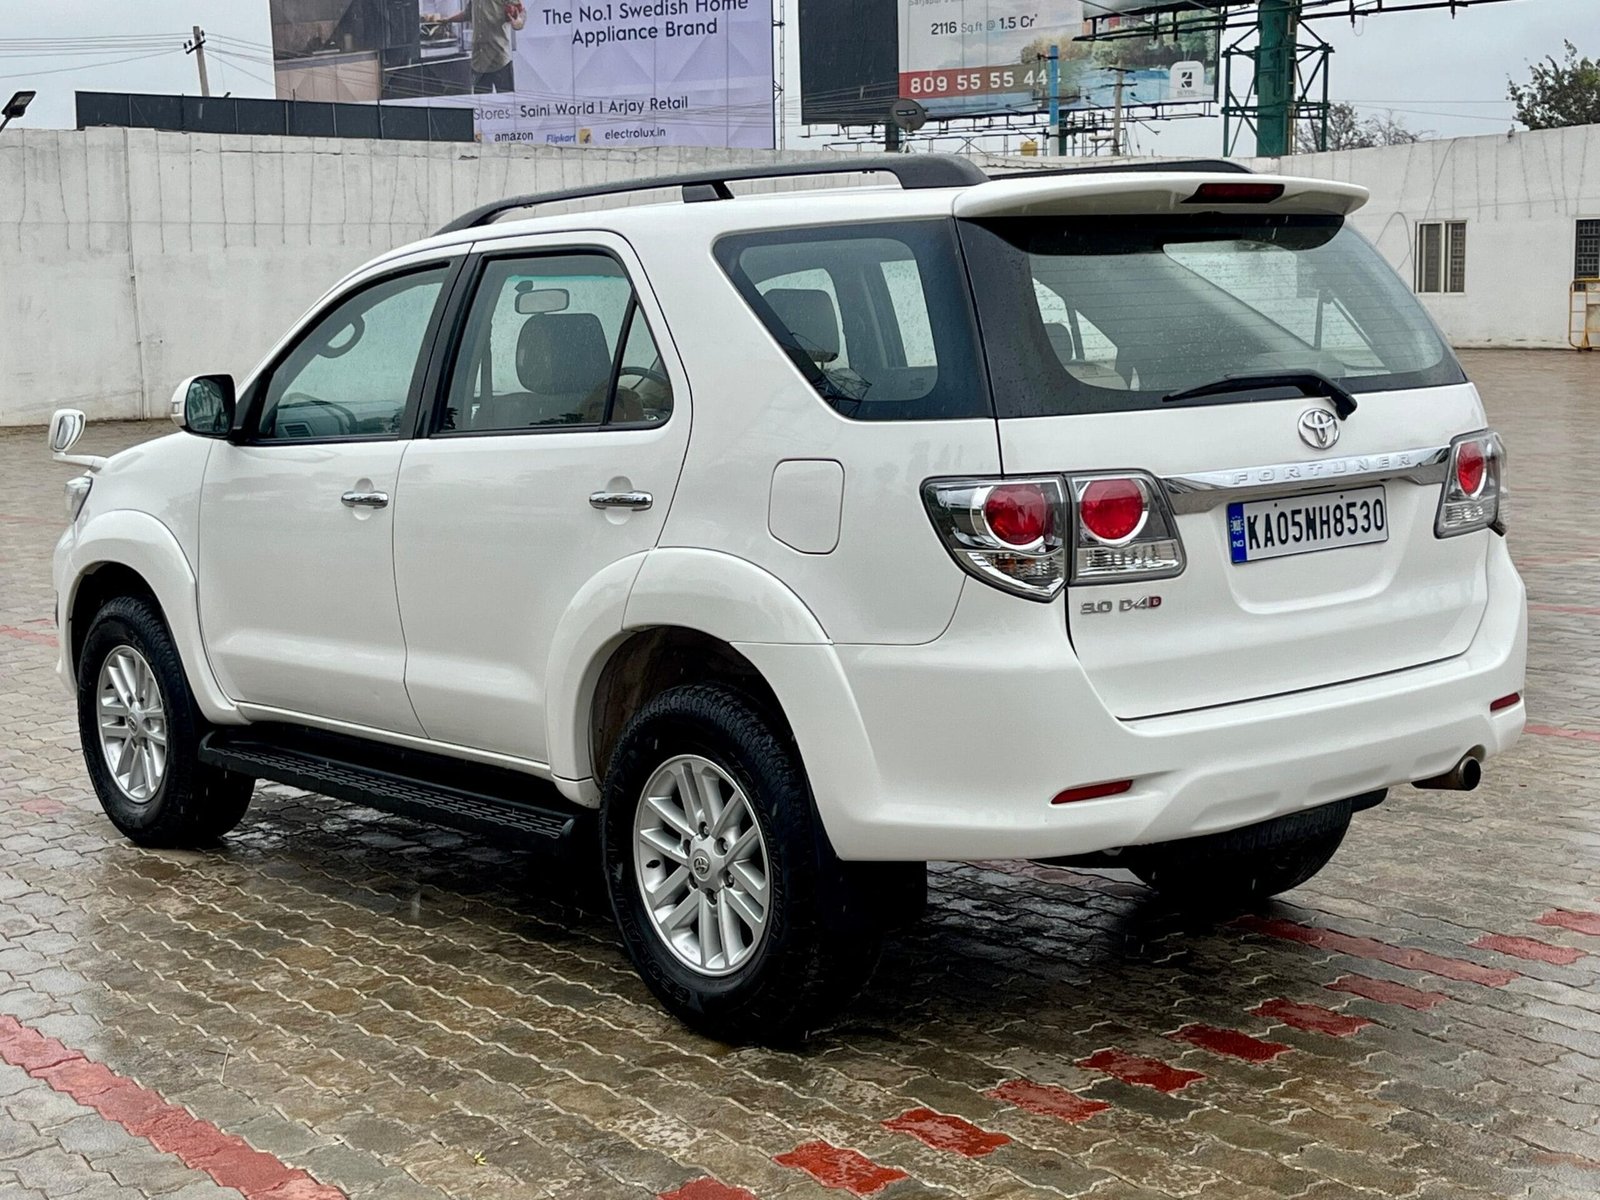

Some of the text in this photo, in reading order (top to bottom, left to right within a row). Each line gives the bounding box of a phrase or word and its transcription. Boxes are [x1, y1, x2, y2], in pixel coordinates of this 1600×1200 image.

[543, 0, 748, 25] The No.1 Swedish Home
[572, 18, 718, 48] Appliance Brand
[931, 21, 957, 35] 2116
[999, 16, 1017, 30] 1.5
[910, 76, 948, 94] 809
[957, 73, 981, 91] 55
[989, 71, 1014, 88] 55
[520, 103, 551, 118] Saini
[555, 100, 595, 116] World
[608, 99, 645, 116] Arjay
[650, 95, 688, 110] Retail
[494, 131, 534, 142] amazon
[546, 134, 576, 144] Flipkart
[604, 126, 667, 140] electrolux.in
[1232, 454, 1412, 486] FORTUNER
[1246, 498, 1385, 551] KA05NH8530
